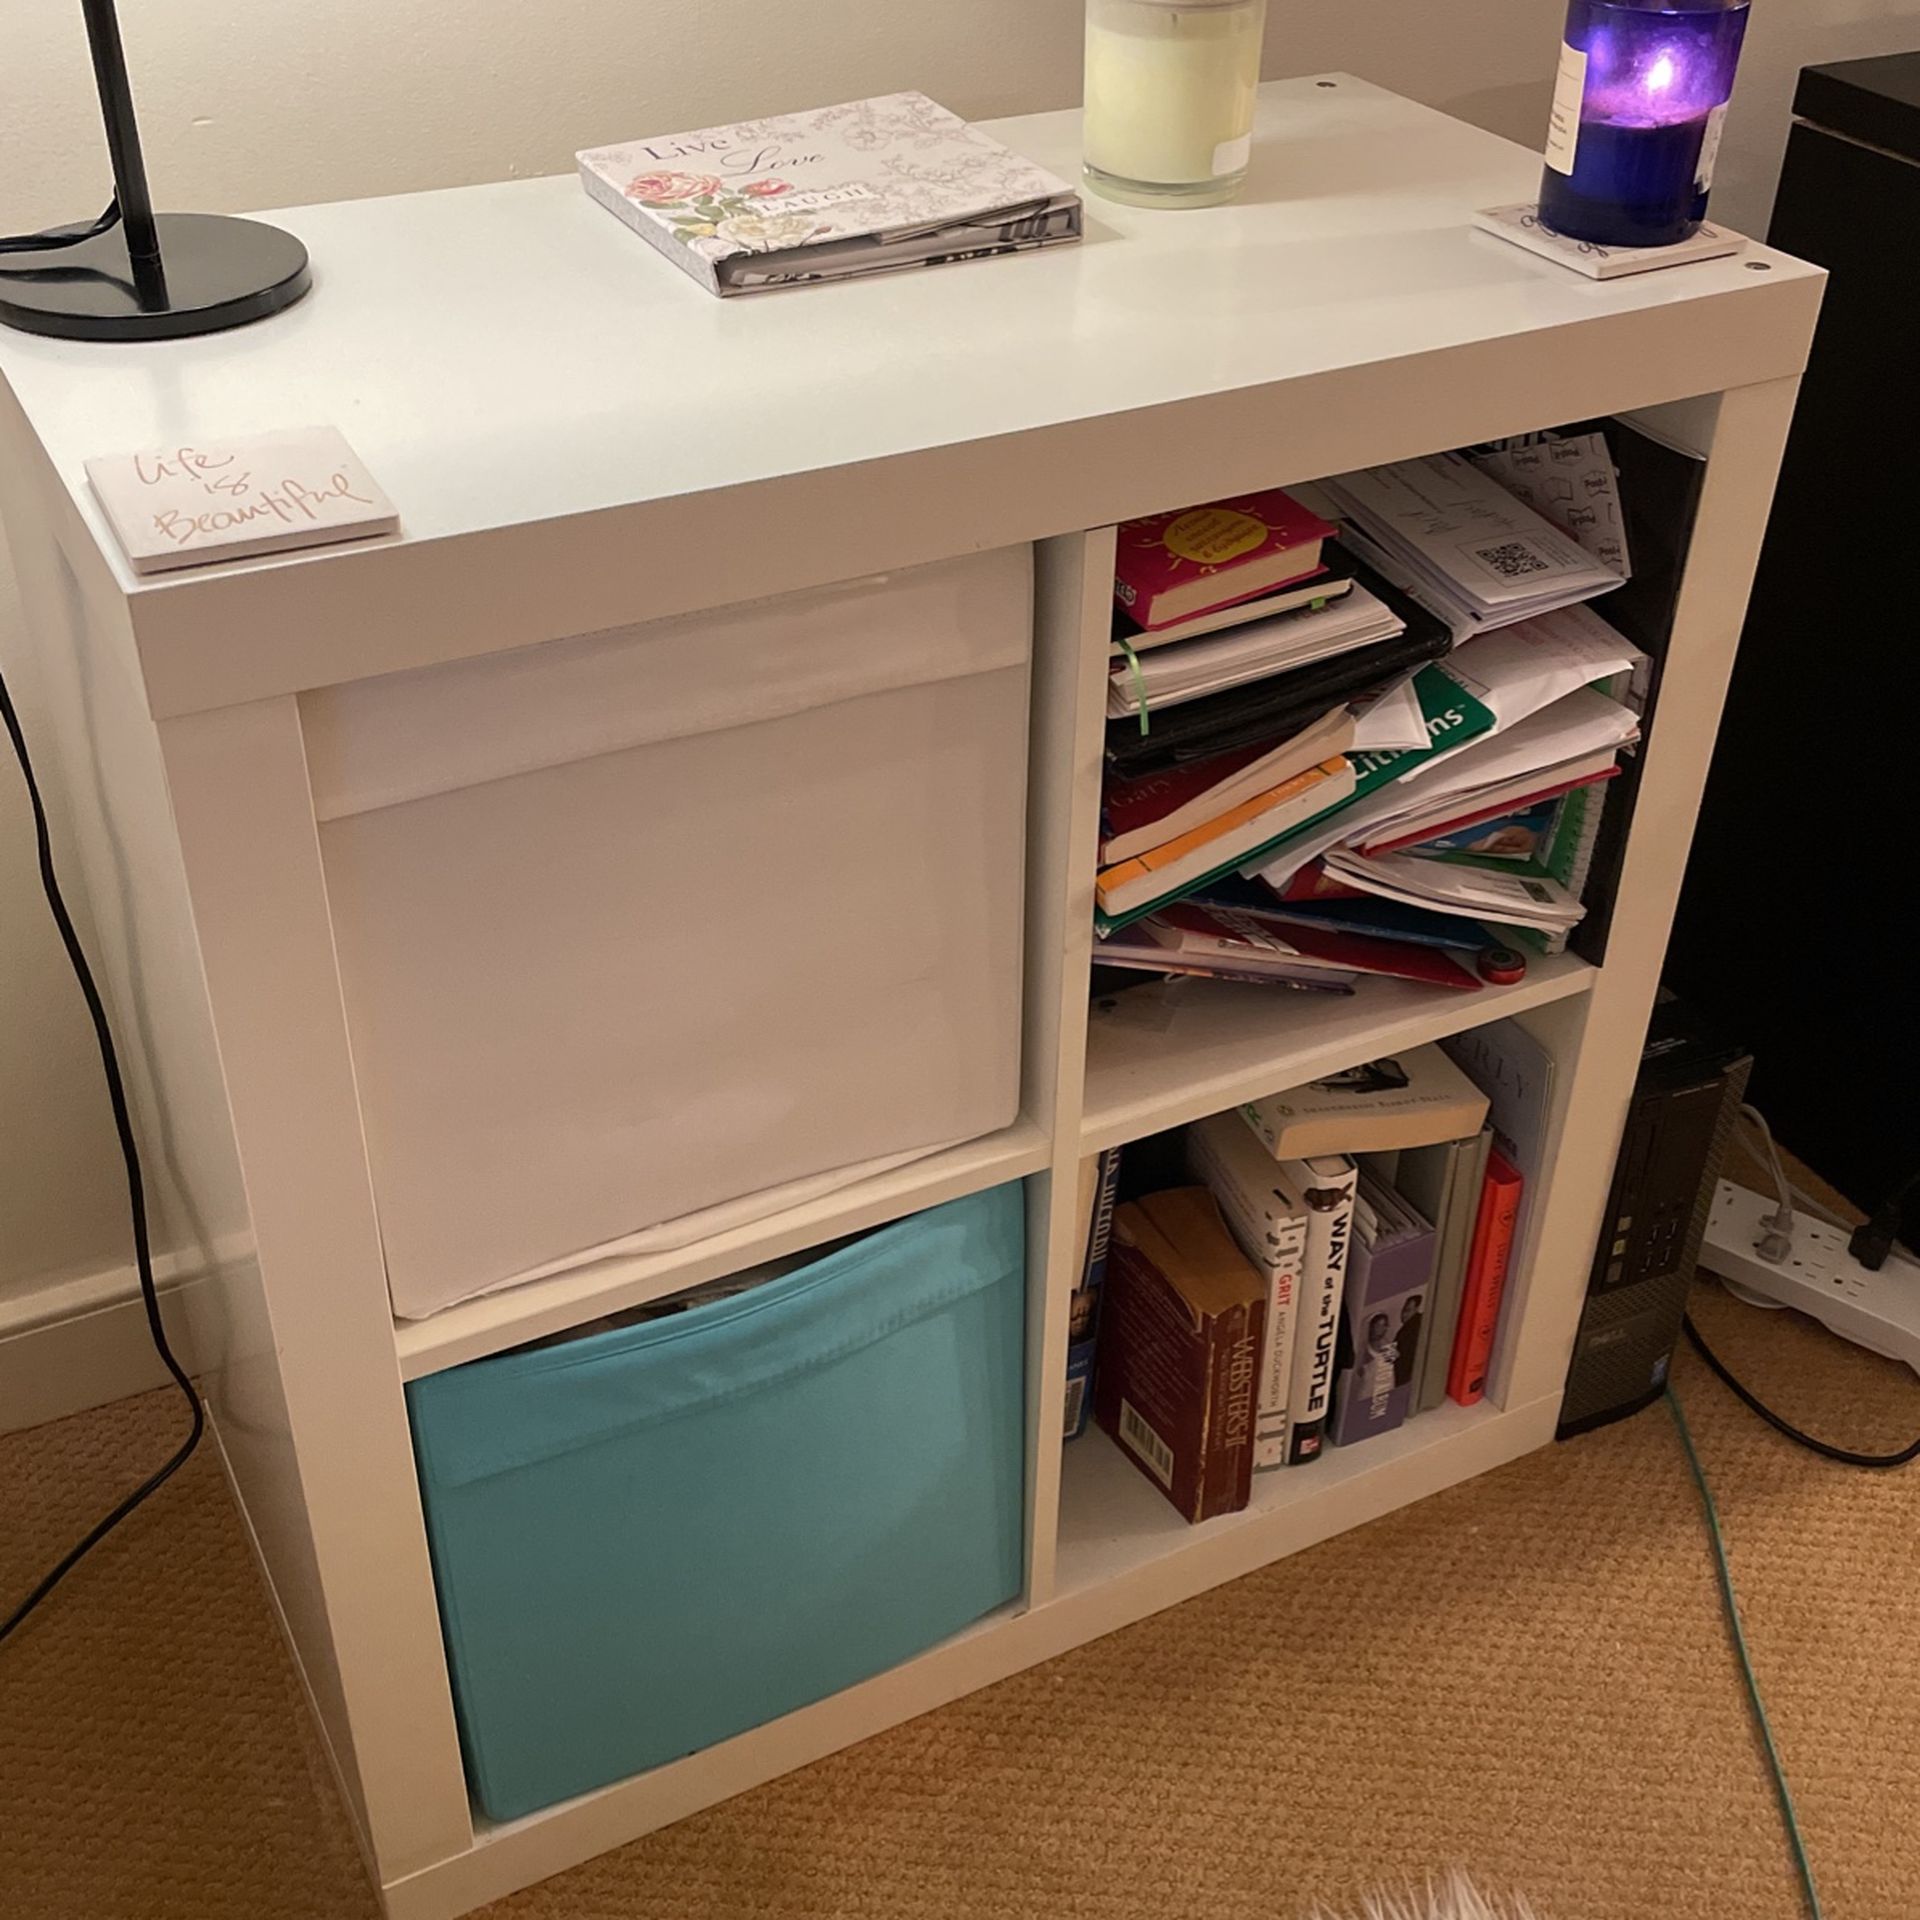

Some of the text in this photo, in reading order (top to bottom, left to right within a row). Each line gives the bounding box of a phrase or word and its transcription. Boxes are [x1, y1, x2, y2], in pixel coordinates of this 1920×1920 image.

[641, 139, 731, 161] Live
[720, 145, 826, 178] Love
[762, 187, 865, 213] LAUGH
[134, 448, 234, 485] Life
[204, 472, 251, 496] is
[153, 473, 373, 544] Beautiful
[1277, 1274, 1293, 1306] GRIT
[1307, 1212, 1349, 1413] WAY of the TURTLE
[1269, 1311, 1287, 1408] ANGELA DUCKWORTH
